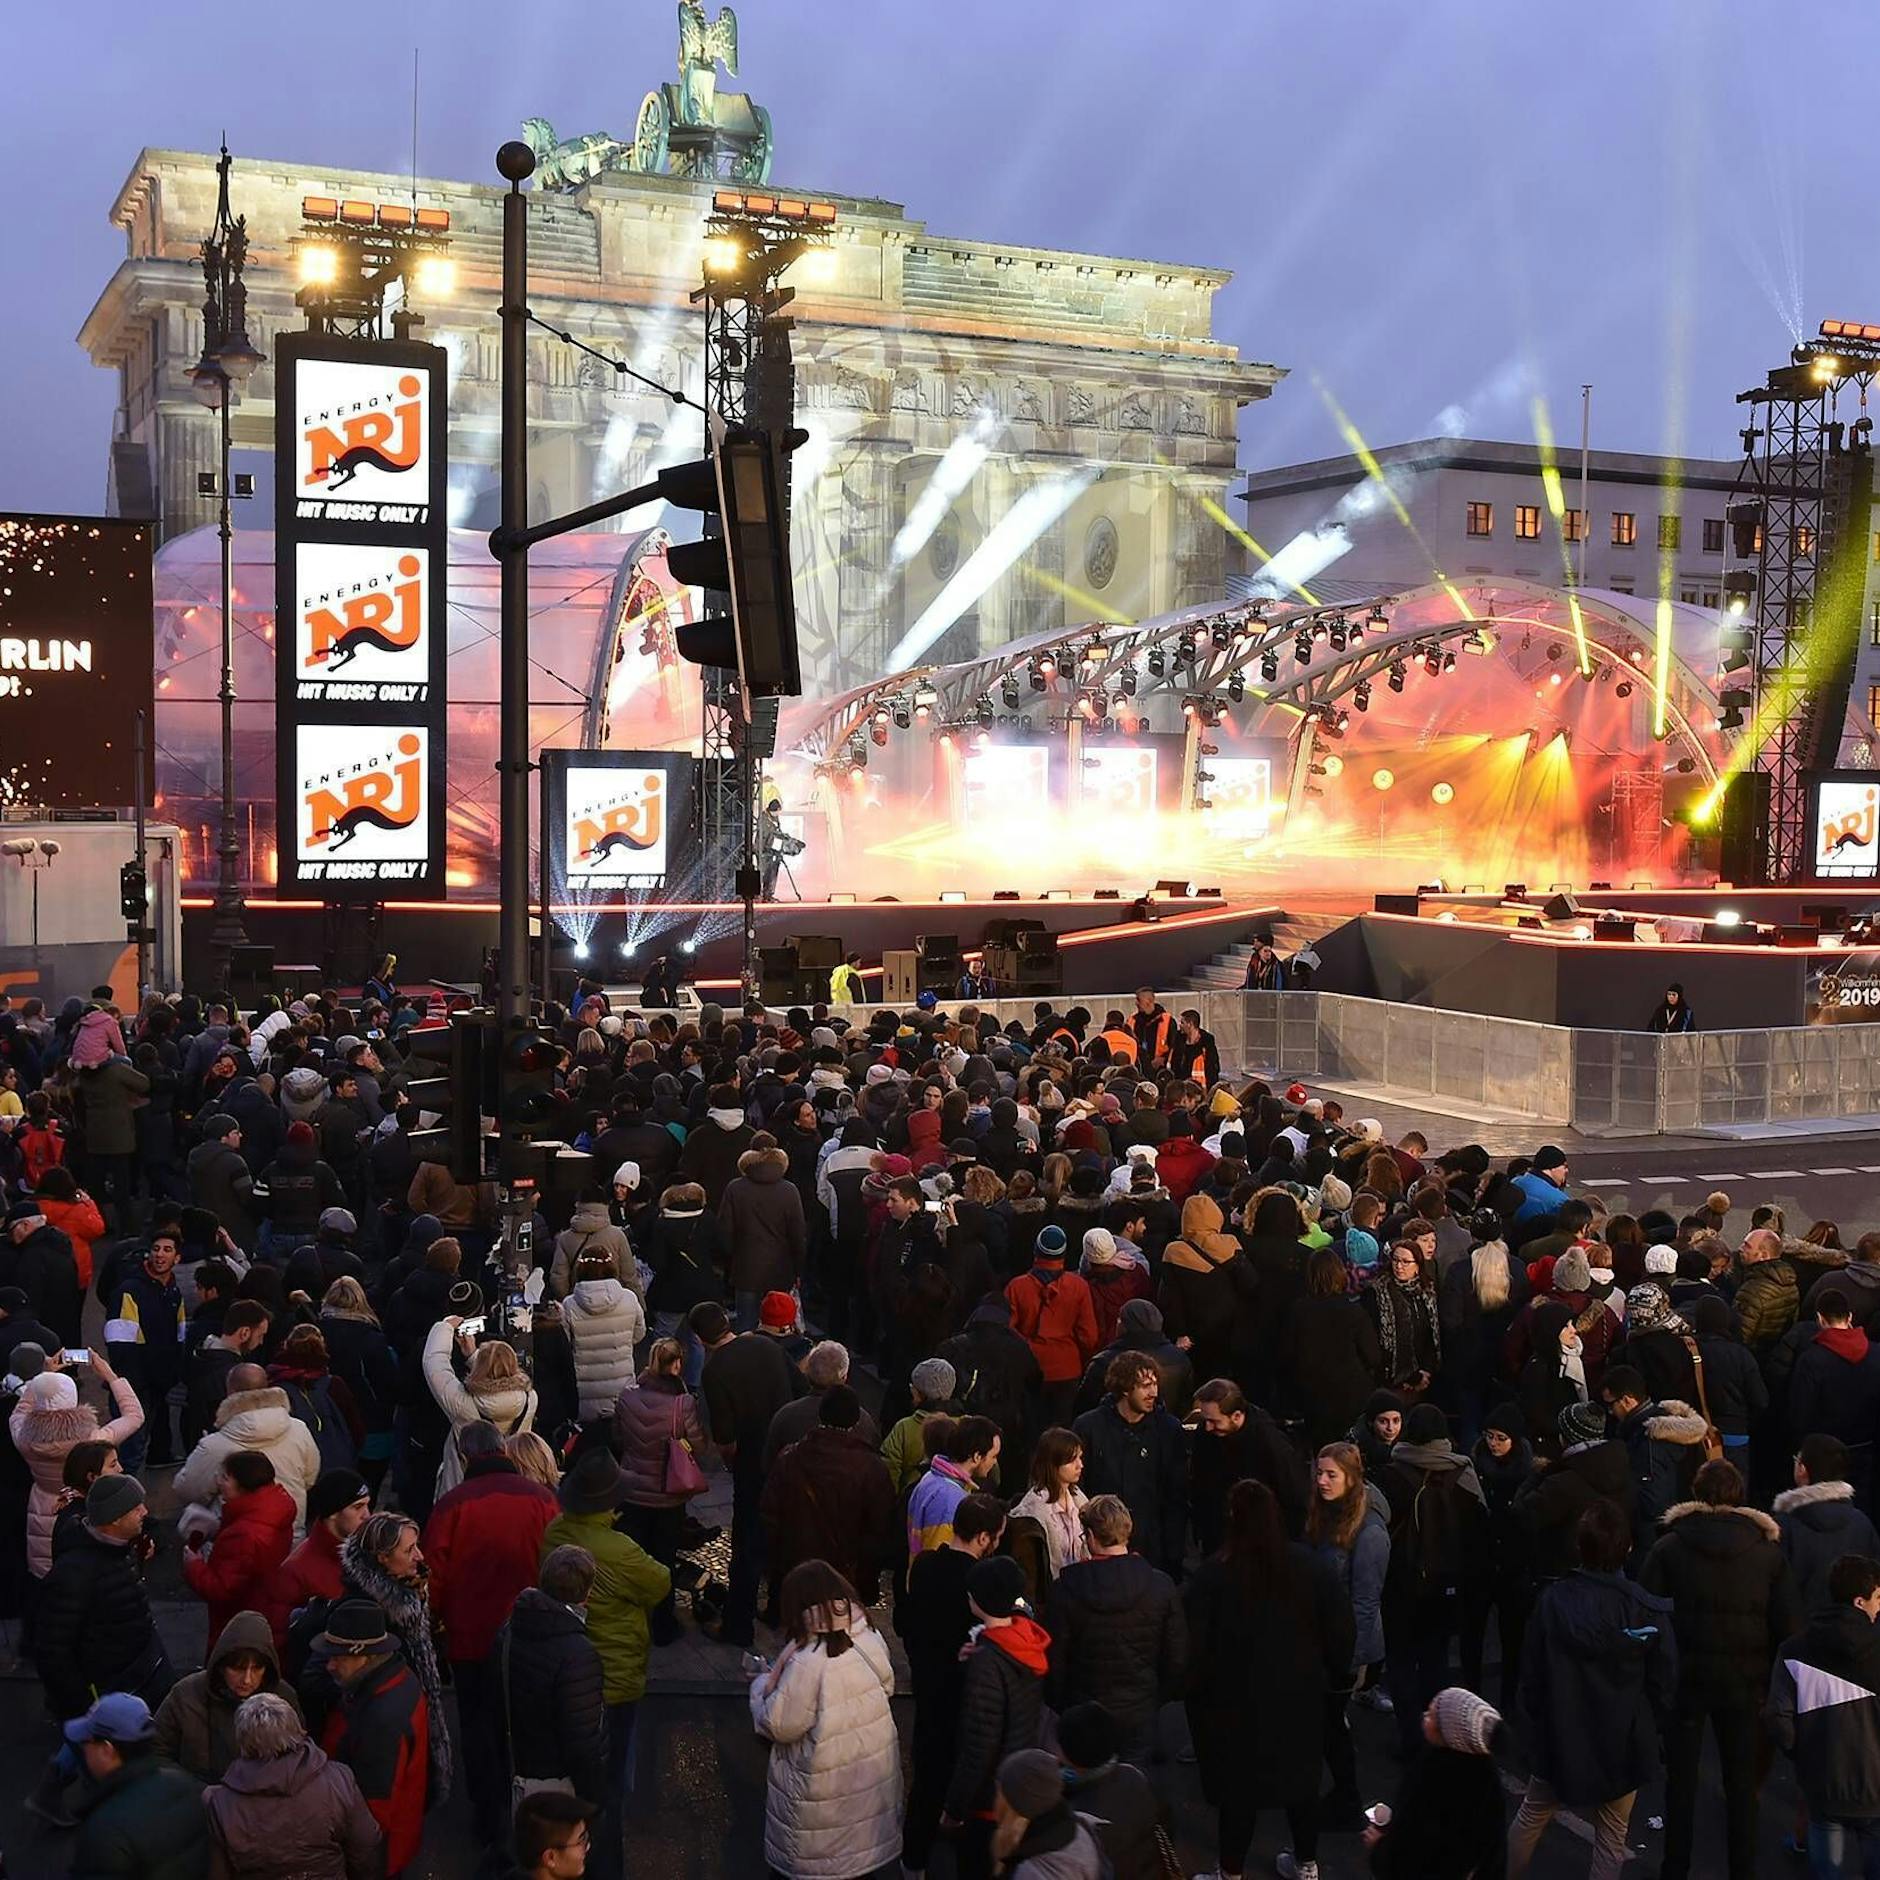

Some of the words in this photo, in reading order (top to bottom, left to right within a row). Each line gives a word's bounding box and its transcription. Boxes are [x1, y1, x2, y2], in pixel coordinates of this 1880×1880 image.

[304, 393, 394, 425] ENERGY
[296, 501, 323, 519] HIT
[325, 502, 377, 522] MUSIC
[304, 573, 393, 608] ENERGY
[297, 683, 325, 700] HIT
[326, 683, 377, 701] MUSIC
[304, 752, 394, 789] ENERGY
[297, 863, 325, 880] HIT
[326, 863, 377, 880] MUSIC
[1840, 988, 1880, 1006] 2019
